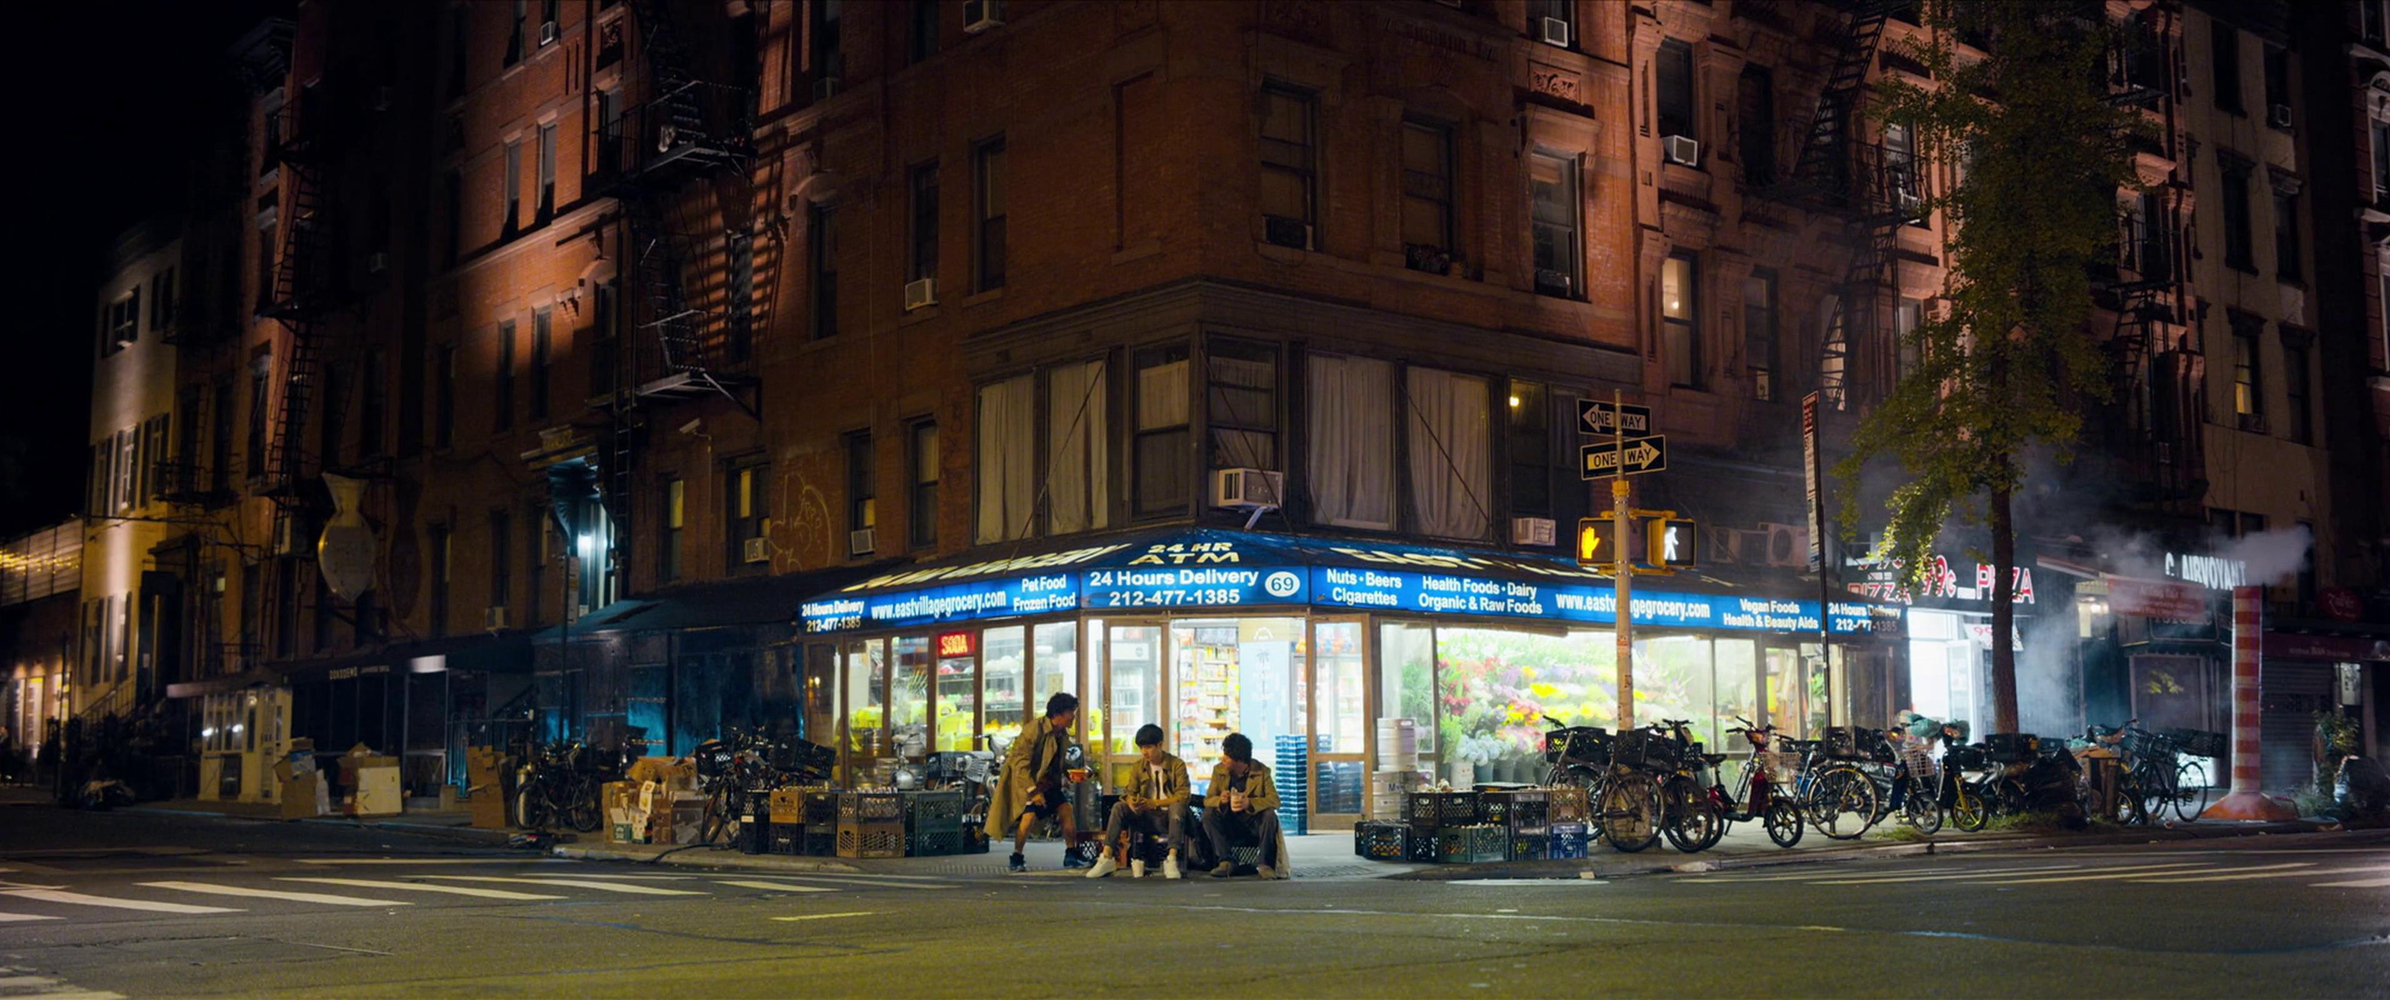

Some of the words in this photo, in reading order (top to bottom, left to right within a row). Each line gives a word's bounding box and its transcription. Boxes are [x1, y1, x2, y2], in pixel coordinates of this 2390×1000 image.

[1589, 411, 1611, 425] ONE
[1620, 414, 1641, 428] WAY
[1593, 452, 1617, 467] ONE
[1627, 447, 1652, 463] WAY
[1147, 544, 1185, 554] 24
[1191, 542, 1233, 552] HR
[1128, 552, 1240, 565] ATM
[1088, 571, 1113, 587] 24
[1117, 569, 1176, 587] Hours
[1179, 568, 1260, 587] Delivery
[1326, 568, 1357, 585] Nuts
[1365, 572, 1402, 588] Beers
[2164, 552, 2246, 591] CAIRVOYANT
[1022, 578, 1039, 593] Pet
[1039, 574, 1067, 590] Food
[1271, 577, 1294, 593] 69
[1422, 576, 1461, 592] Health
[1463, 579, 1500, 595] Foods
[1507, 582, 1537, 600] Dairy
[1976, 563, 2035, 604] PIZA
[871, 590, 1006, 620] www.eastvillagegrocery.com
[1013, 594, 1048, 612] Frozen
[1048, 591, 1077, 608] Food
[1108, 588, 1241, 607] 212-477-1385
[1332, 586, 1398, 606] Cigarettes
[1418, 592, 1467, 612] Organic
[1468, 597, 1477, 611] &
[1480, 599, 1506, 613] Raw
[1506, 600, 1543, 615] Foods
[1740, 598, 1770, 614] Vegan
[1770, 600, 1800, 614] Foods
[801, 603, 811, 617] 24
[811, 602, 834, 617] Hours
[834, 599, 865, 615] Delivery
[1555, 593, 1711, 621] www.eastvgegrocery.com
[1828, 602, 1840, 615] 24
[1840, 602, 1867, 617] Hours
[1867, 604, 1902, 620] Delivery
[806, 615, 862, 632] 212-477-1385
[1723, 612, 1755, 627] Health
[1755, 614, 1764, 628] &
[1764, 615, 1797, 632] Beauty
[1797, 616, 1819, 630] Aids
[941, 633, 969, 655] SODA
